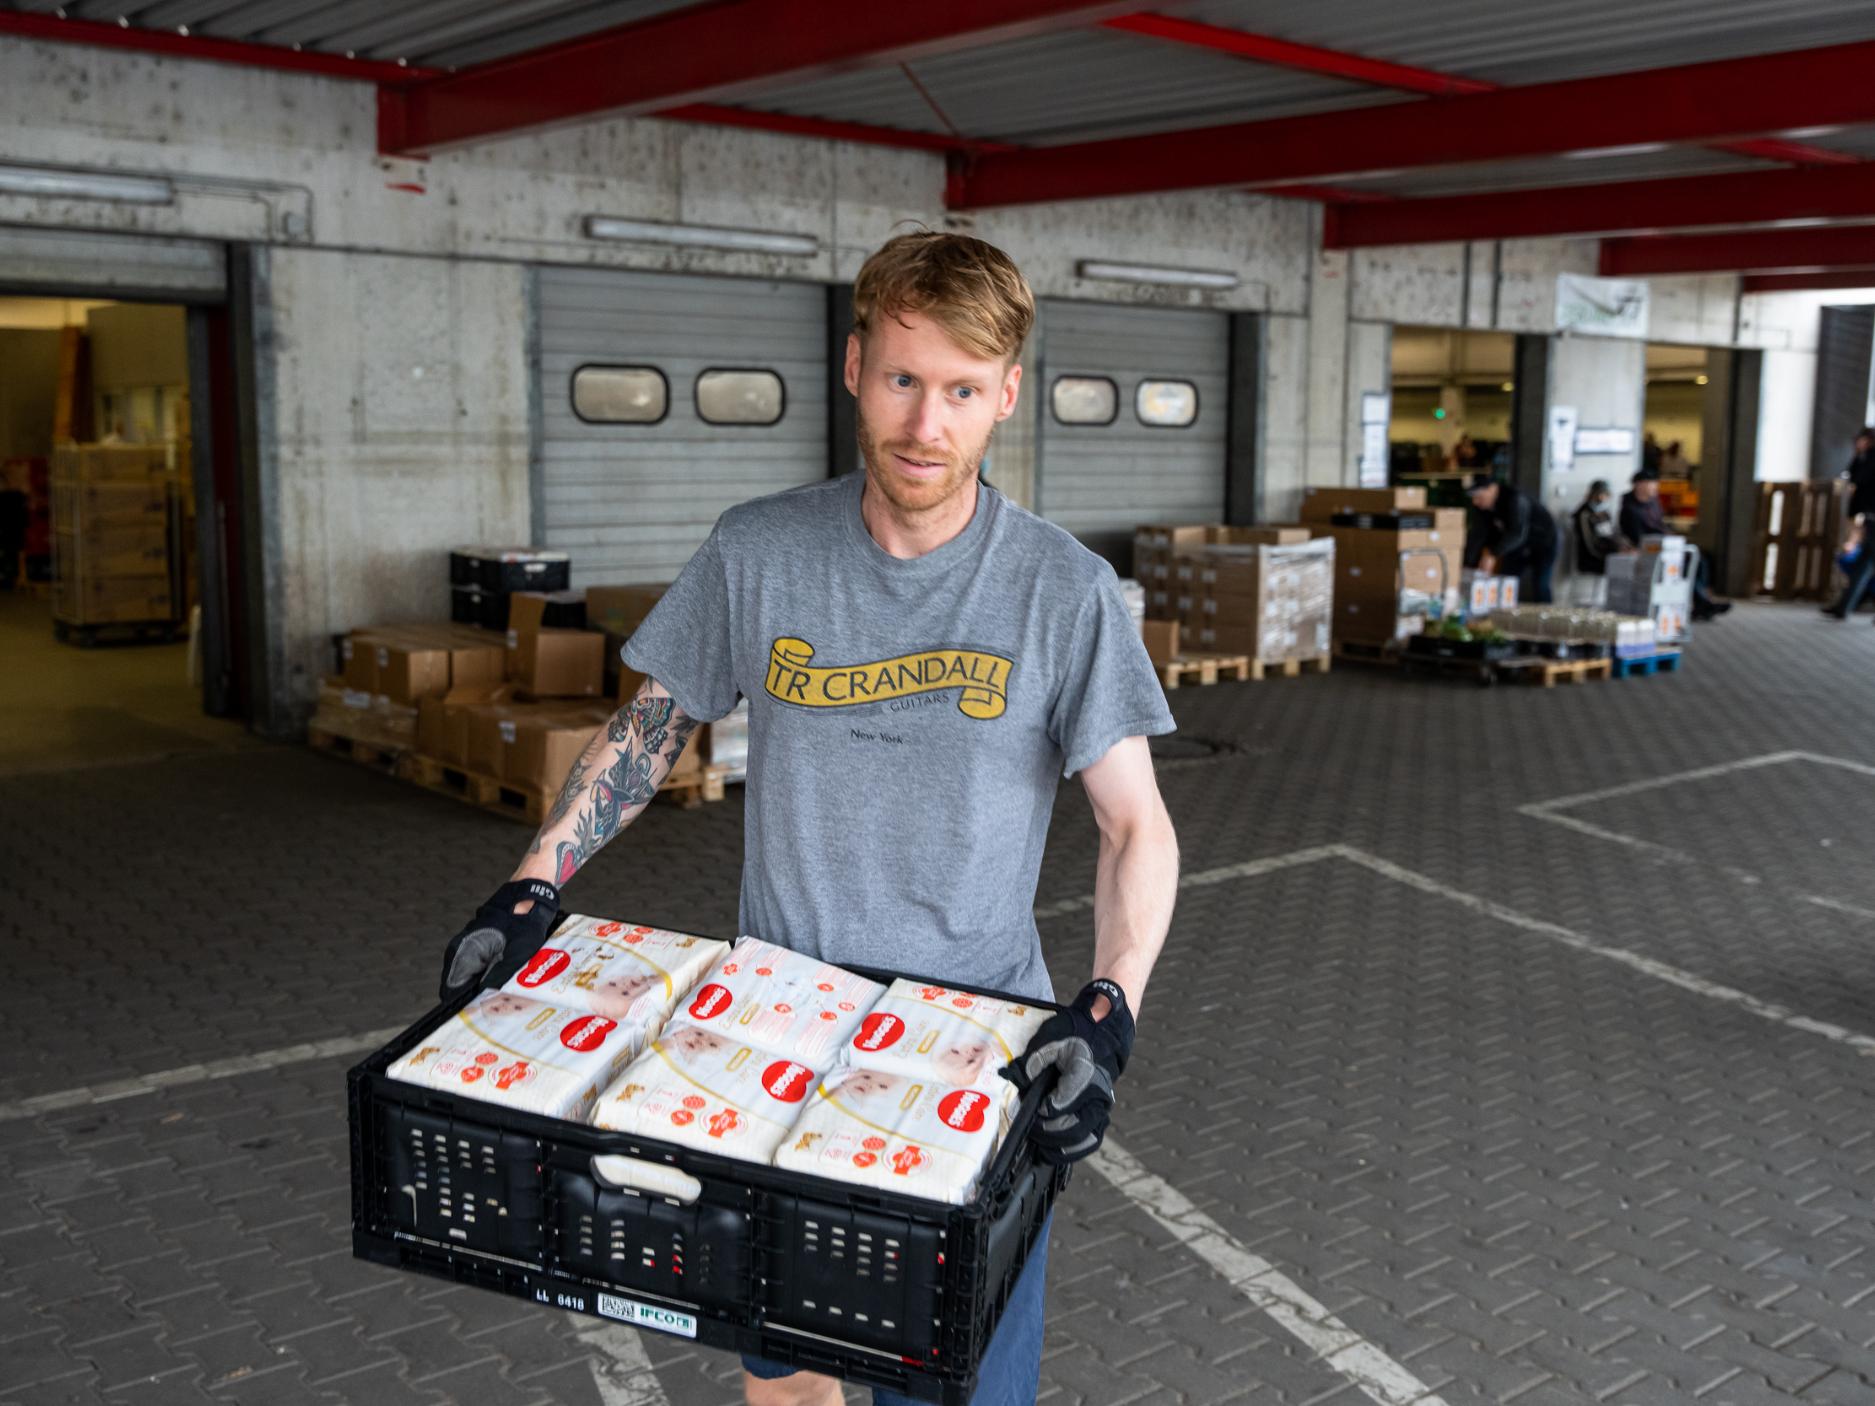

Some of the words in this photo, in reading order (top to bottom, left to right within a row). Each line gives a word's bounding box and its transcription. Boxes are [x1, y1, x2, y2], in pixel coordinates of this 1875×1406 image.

[772, 660, 811, 700] TR
[822, 656, 1000, 702] CRANDALL
[889, 693, 950, 713] GUITARS
[850, 728, 877, 741] New
[879, 732, 904, 745] York
